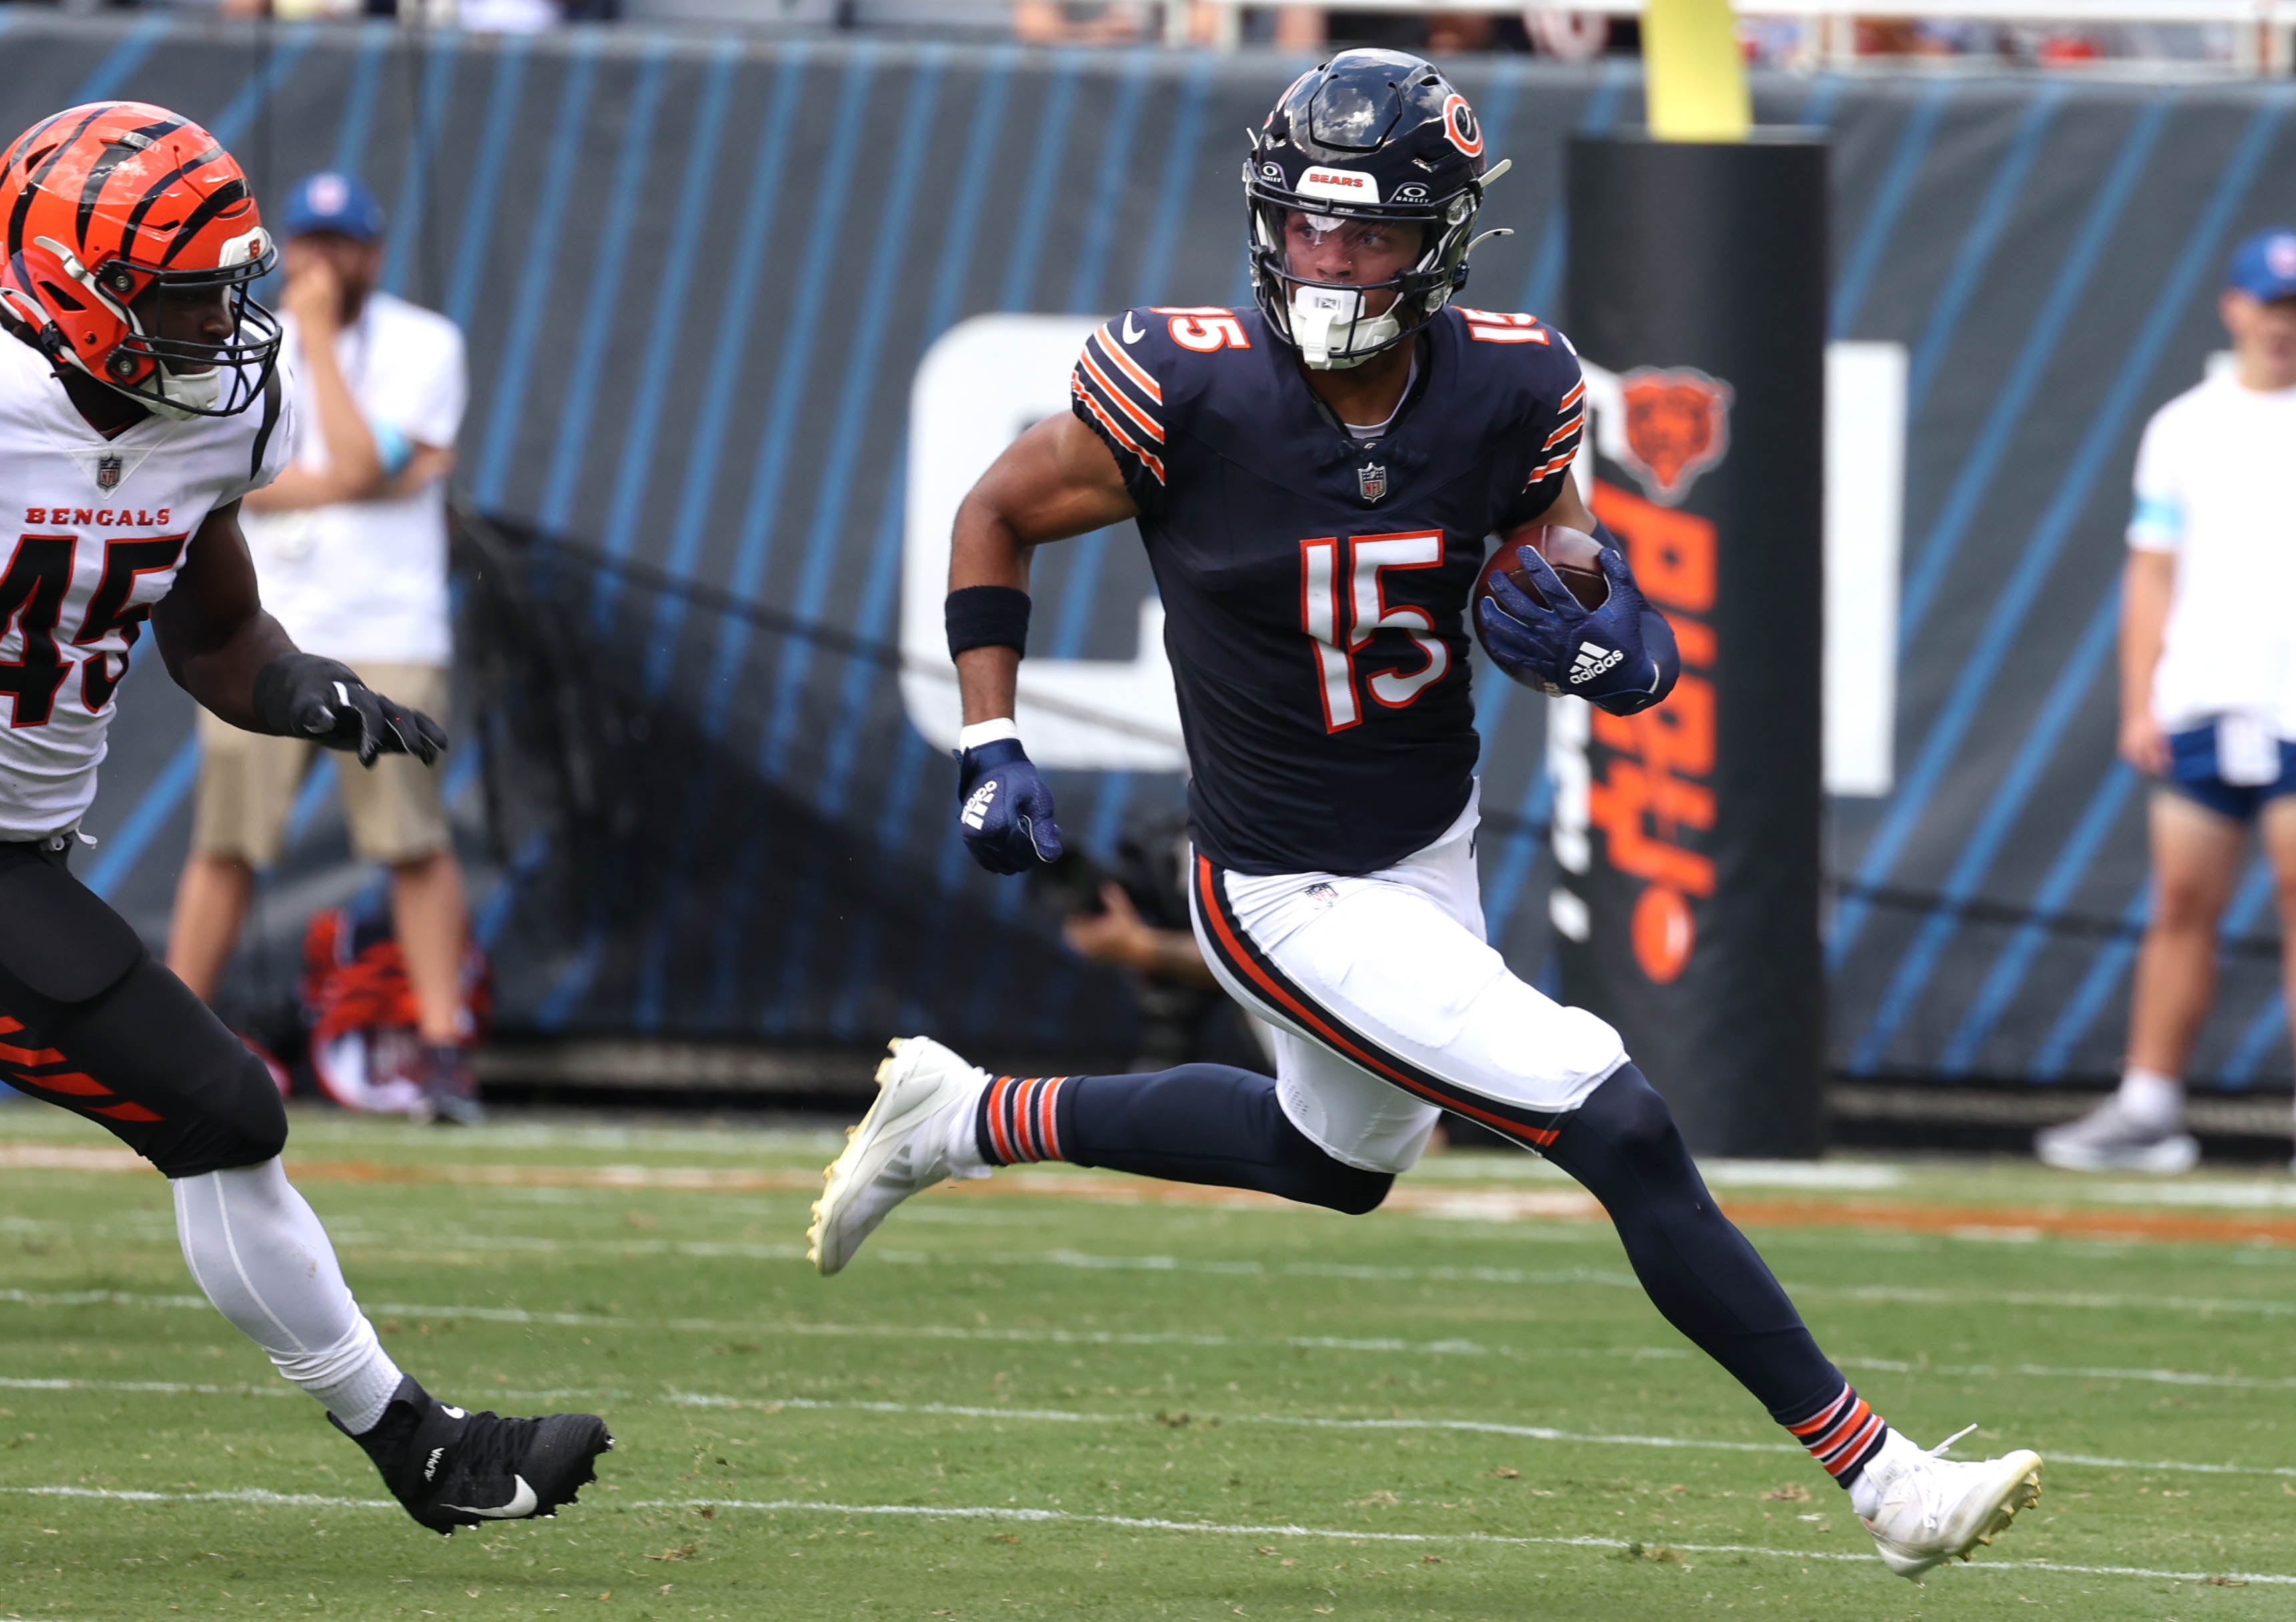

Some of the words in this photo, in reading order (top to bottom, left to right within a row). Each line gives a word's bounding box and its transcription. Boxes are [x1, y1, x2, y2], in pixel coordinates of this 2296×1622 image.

[1310, 174, 1363, 188] BEARS
[1396, 196, 1430, 204] OAKLEY
[1149, 306, 1251, 352] 15
[25, 508, 171, 526] BENGALS
[0, 531, 190, 728] 45
[1300, 529, 1451, 734] 15
[1569, 650, 1624, 684] adidas
[424, 1447, 445, 1482] ALPHA
